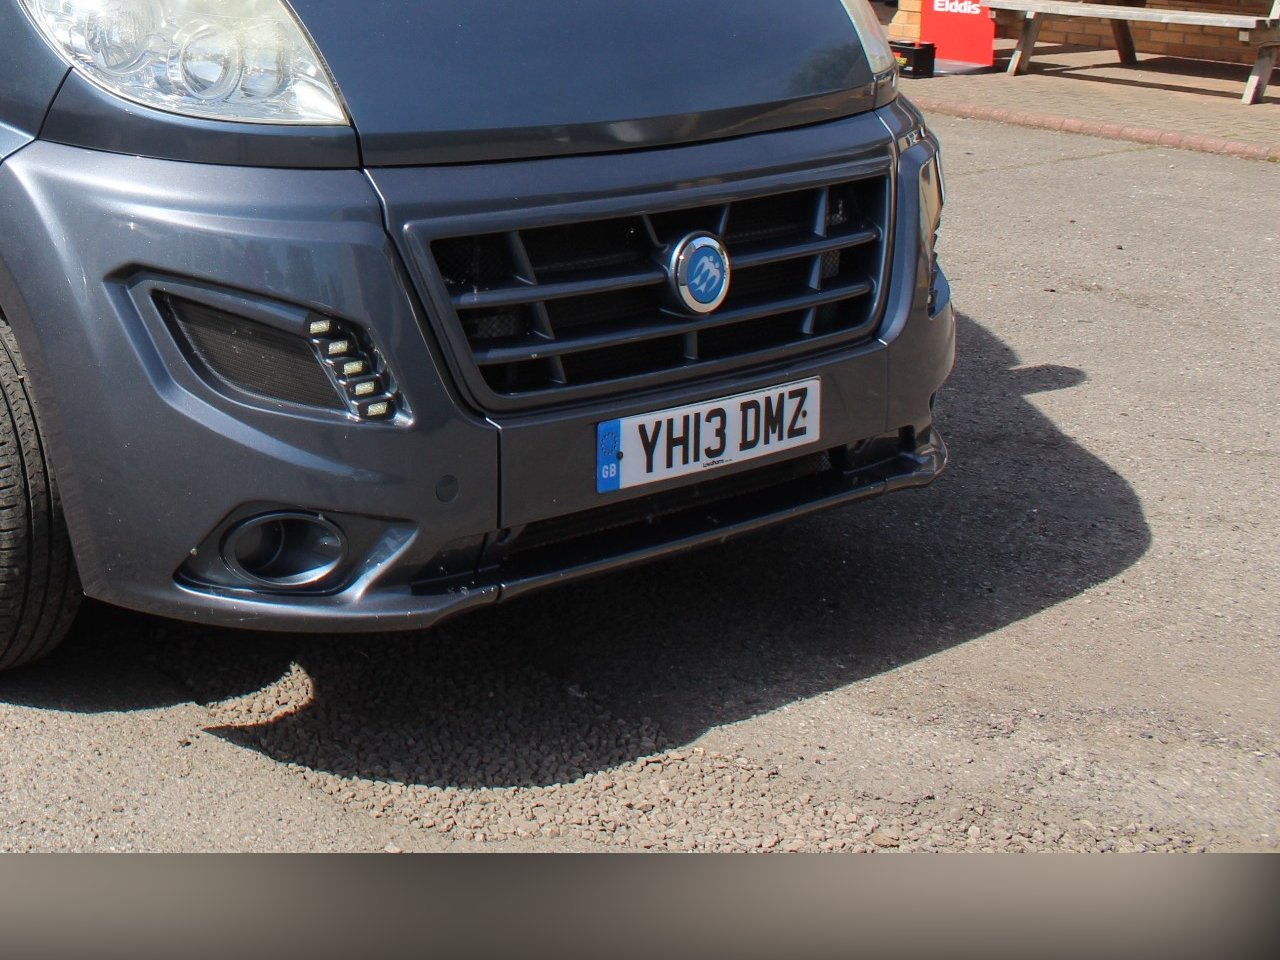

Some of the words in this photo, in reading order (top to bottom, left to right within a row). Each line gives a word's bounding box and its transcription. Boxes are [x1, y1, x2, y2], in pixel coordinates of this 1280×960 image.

[638, 407, 727, 473] YH13
[739, 387, 808, 452] DMZ
[601, 463, 617, 479] GB
